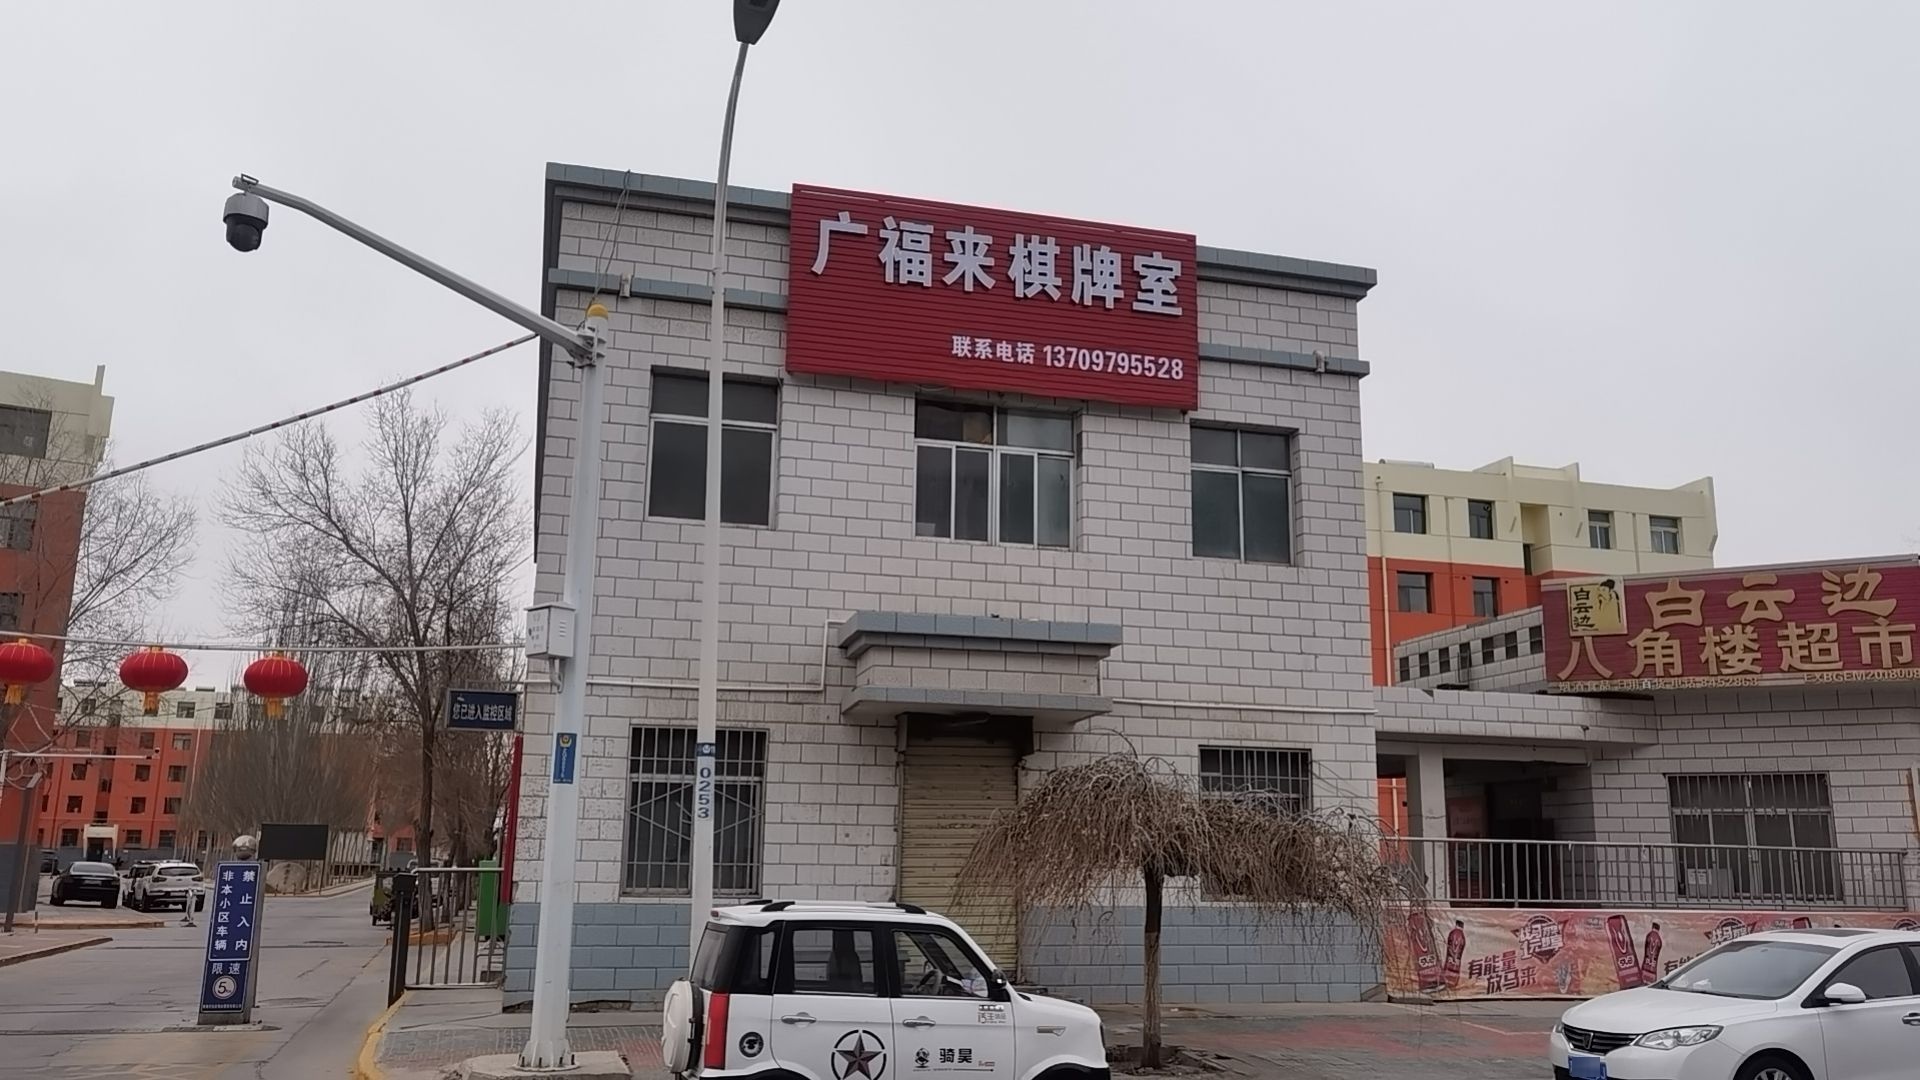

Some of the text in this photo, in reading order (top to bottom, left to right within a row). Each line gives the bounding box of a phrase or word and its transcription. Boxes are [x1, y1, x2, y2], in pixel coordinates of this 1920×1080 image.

[811, 211, 1183, 316] 广福来棋牌室
[951, 335, 1184, 380] 联系电话 13709795528
[1573, 587, 1596, 628] 白云边
[1645, 564, 1898, 630] 白云边
[1556, 617, 1917, 680] 八角楼超市
[697, 766, 712, 819] 0253
[214, 869, 235, 952] 非本小区车辆
[235, 869, 256, 952] 禁止入内
[211, 962, 241, 975] 限速
[1468, 950, 1517, 979] 有能量
[1486, 965, 1537, 995] 放马来
[939, 1048, 973, 1064] 骑昊
